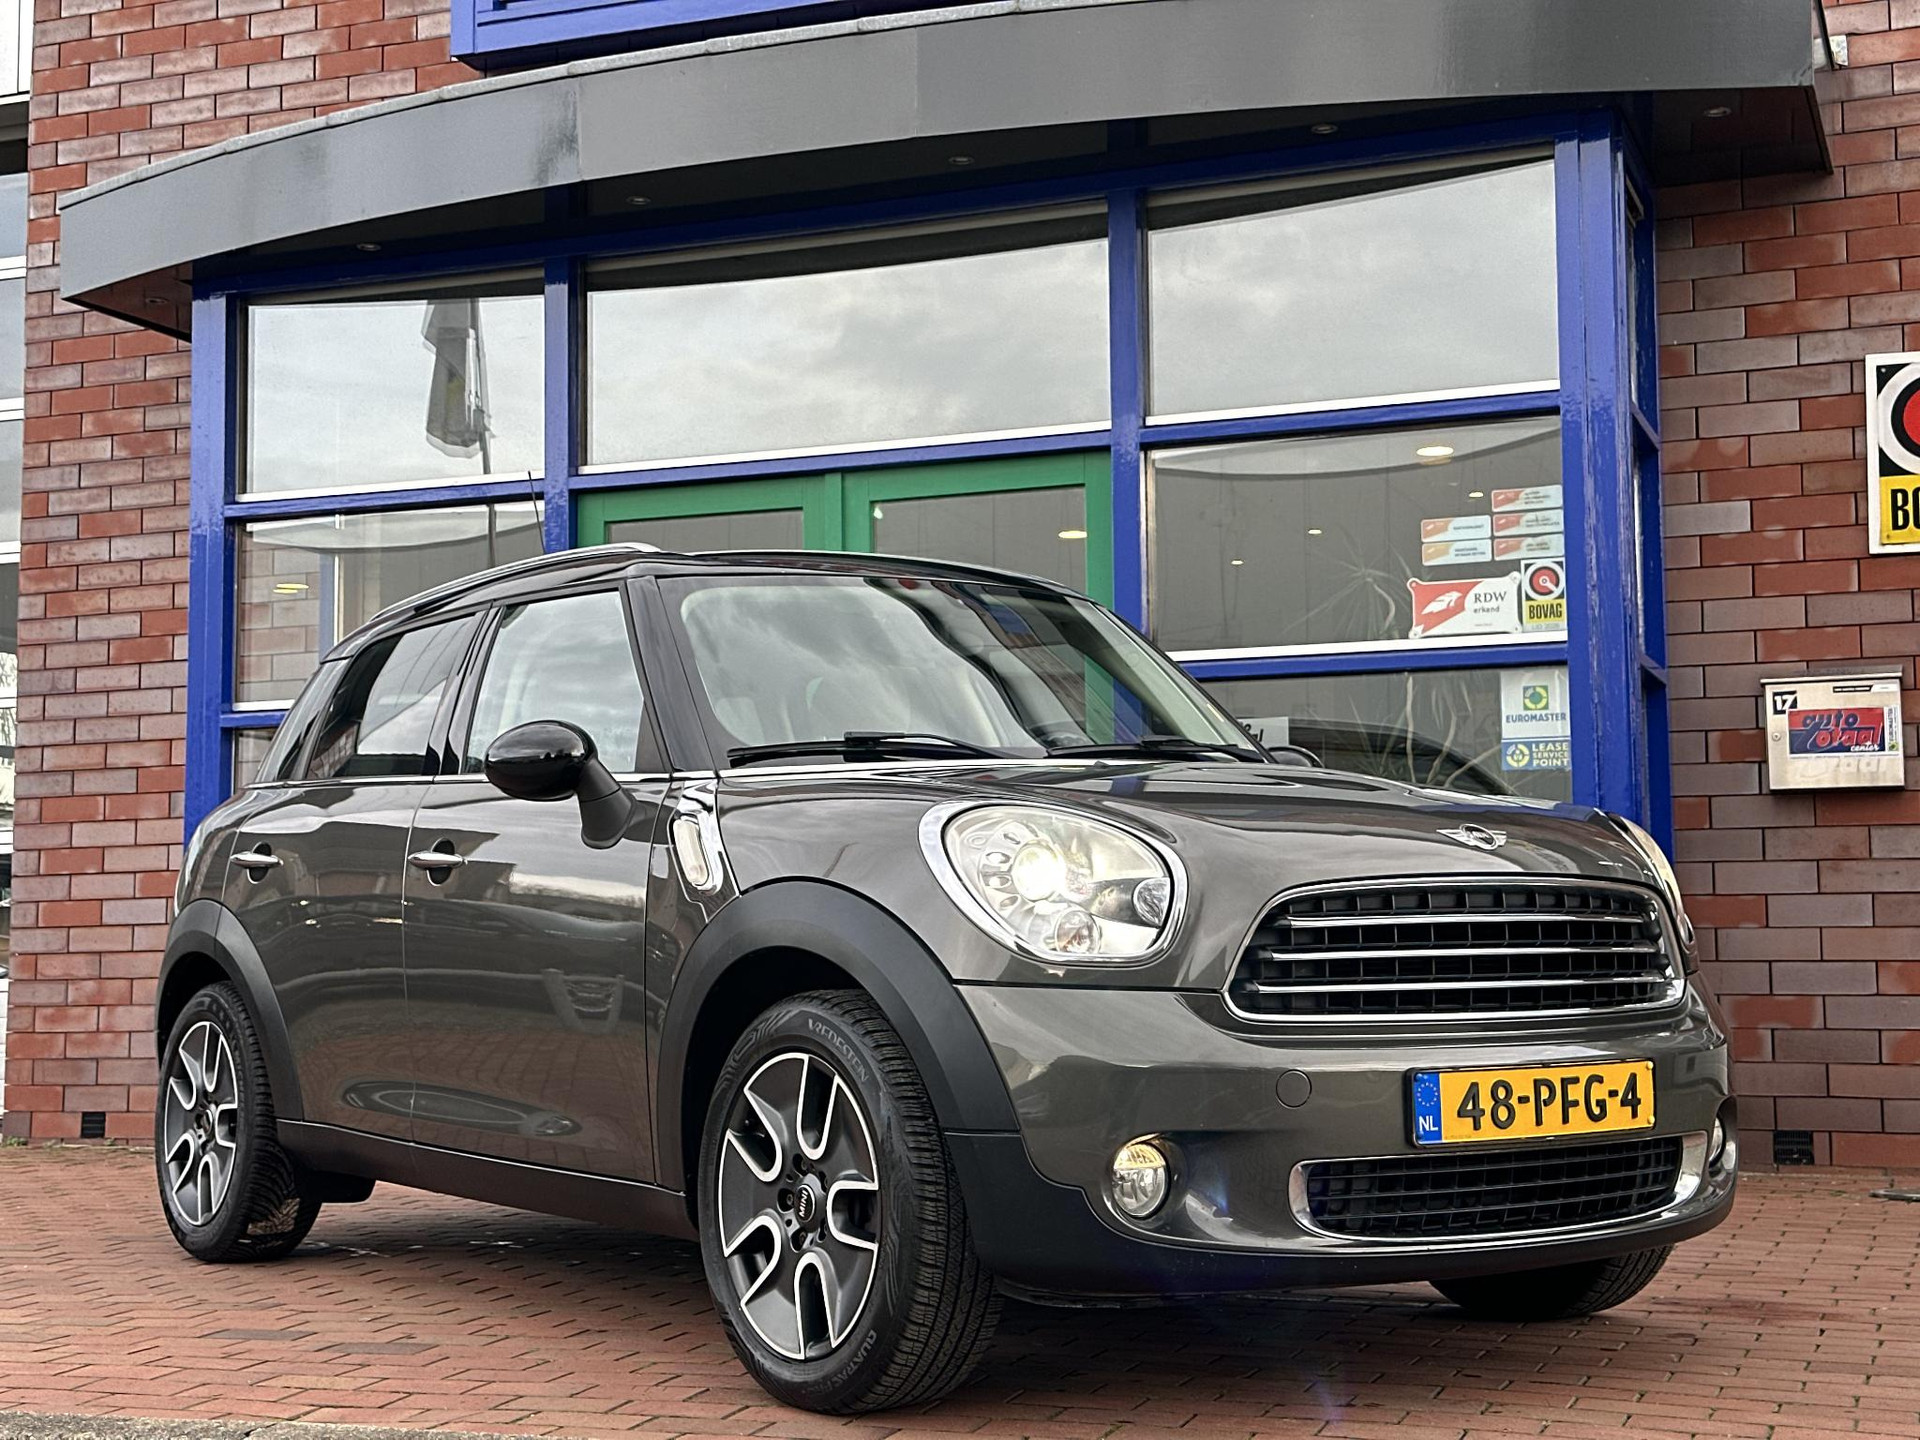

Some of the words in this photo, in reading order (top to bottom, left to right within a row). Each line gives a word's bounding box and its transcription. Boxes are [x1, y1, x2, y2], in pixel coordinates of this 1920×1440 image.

[1473, 591, 1507, 604] RDW
[1473, 606, 1500, 614] erkend
[1528, 603, 1563, 620] BOVAG
[1774, 694, 1798, 711] 17
[1505, 712, 1567, 724] EUROMASTER
[1532, 742, 1569, 752] LEASE
[1851, 741, 1880, 752] center
[1532, 751, 1569, 759] SERVICE
[1532, 758, 1569, 768] POINT
[1457, 1072, 1642, 1131] 48-PFG-4
[1418, 1115, 1439, 1132] NL
[799, 1190, 808, 1218] MINI
